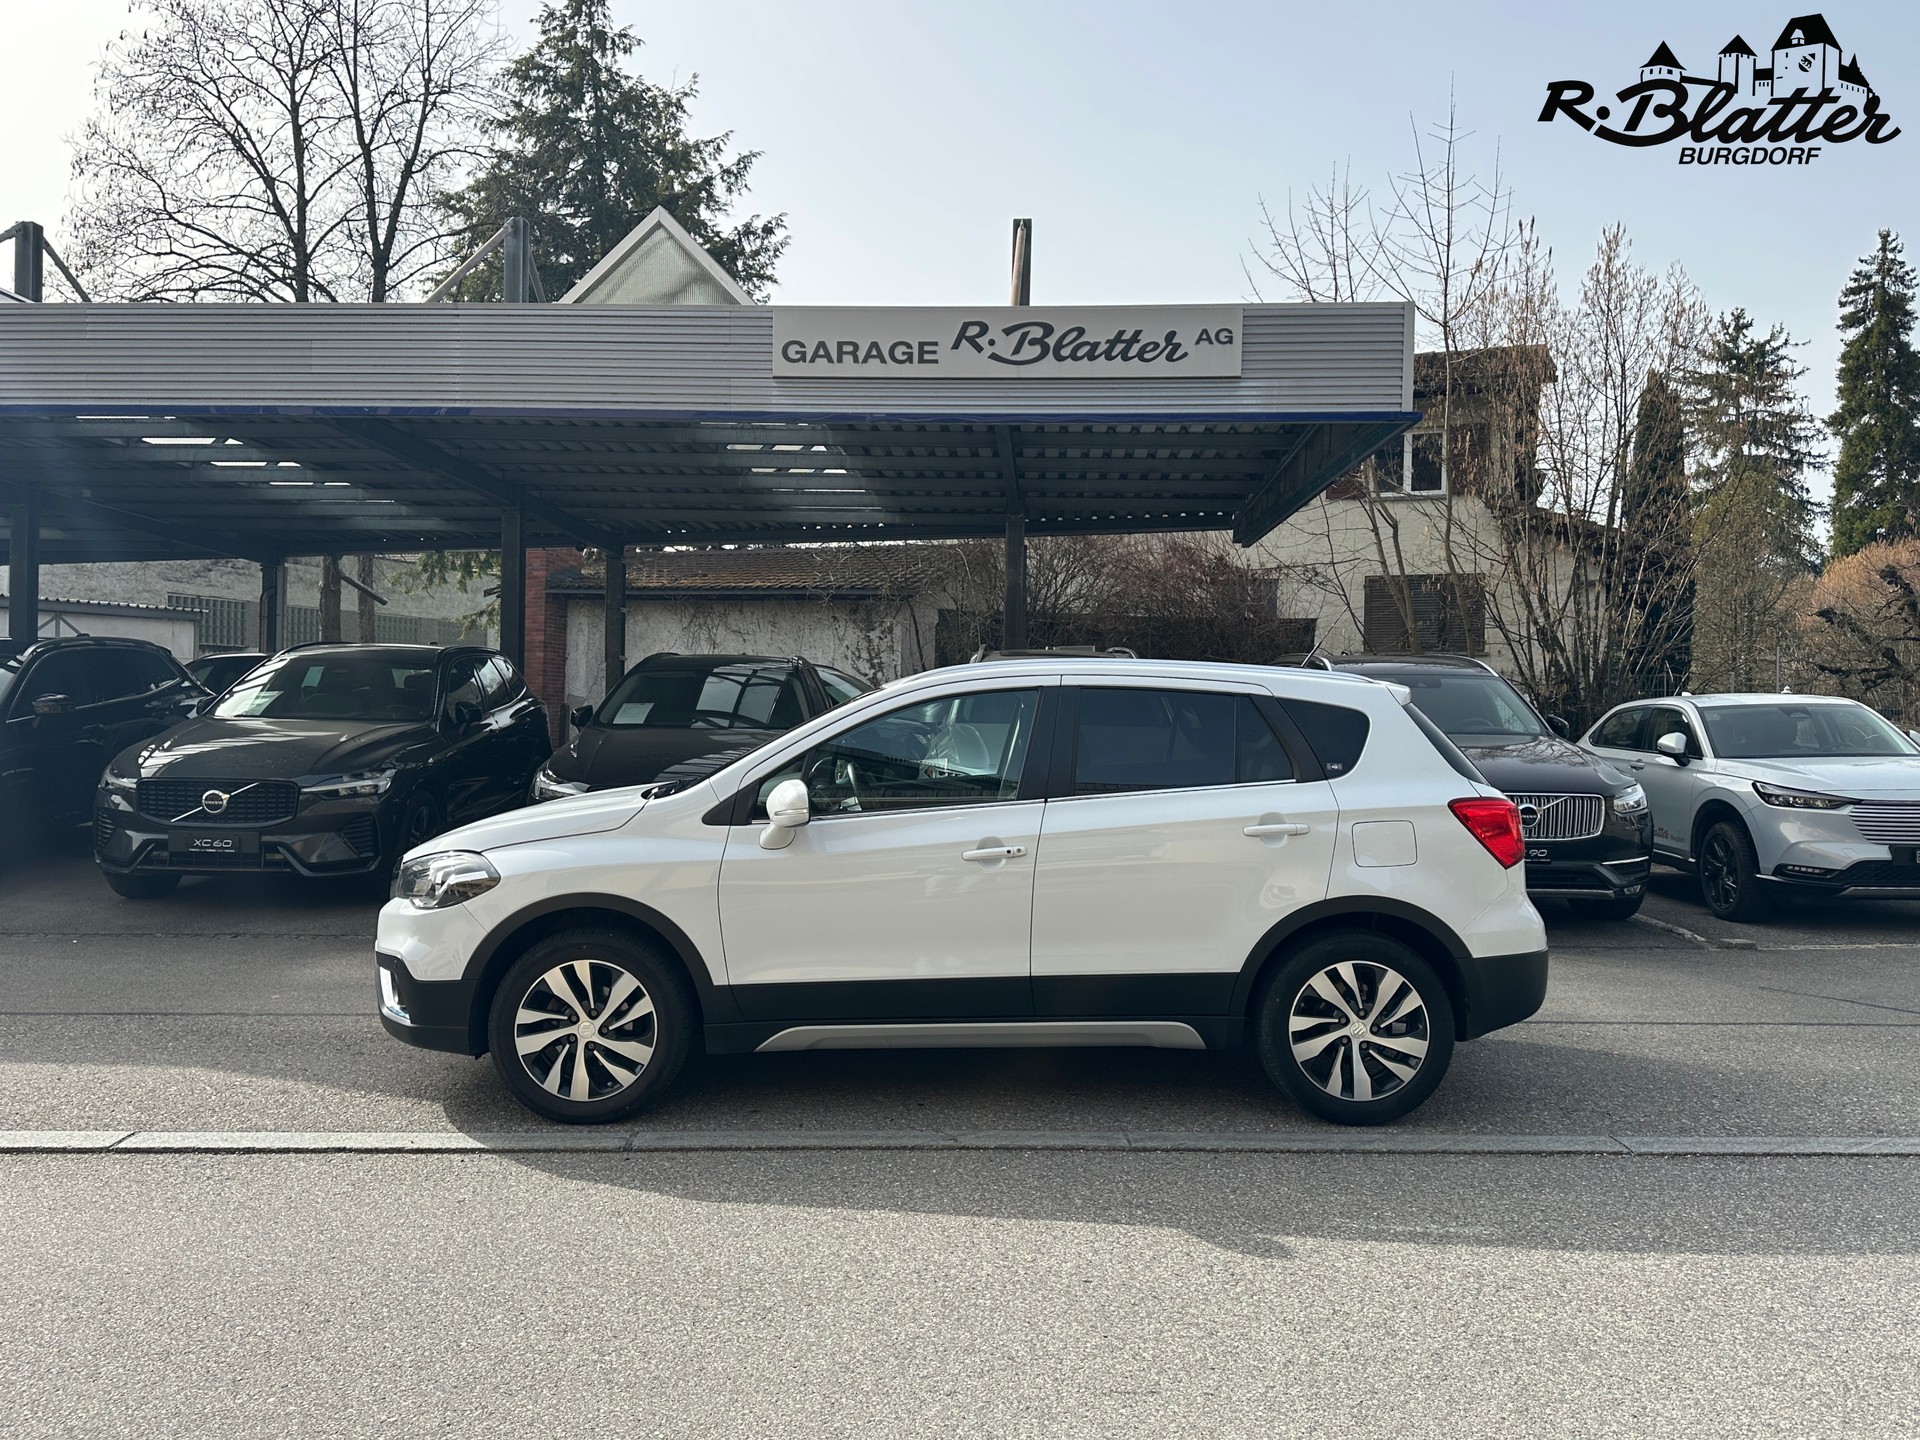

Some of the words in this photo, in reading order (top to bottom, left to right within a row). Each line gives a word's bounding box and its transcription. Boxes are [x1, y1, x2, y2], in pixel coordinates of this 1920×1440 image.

[781, 340, 939, 364] GARAGE
[987, 321, 1189, 366] Blatter
[1195, 327, 1234, 345] AG
[1525, 849, 1548, 857] 90
